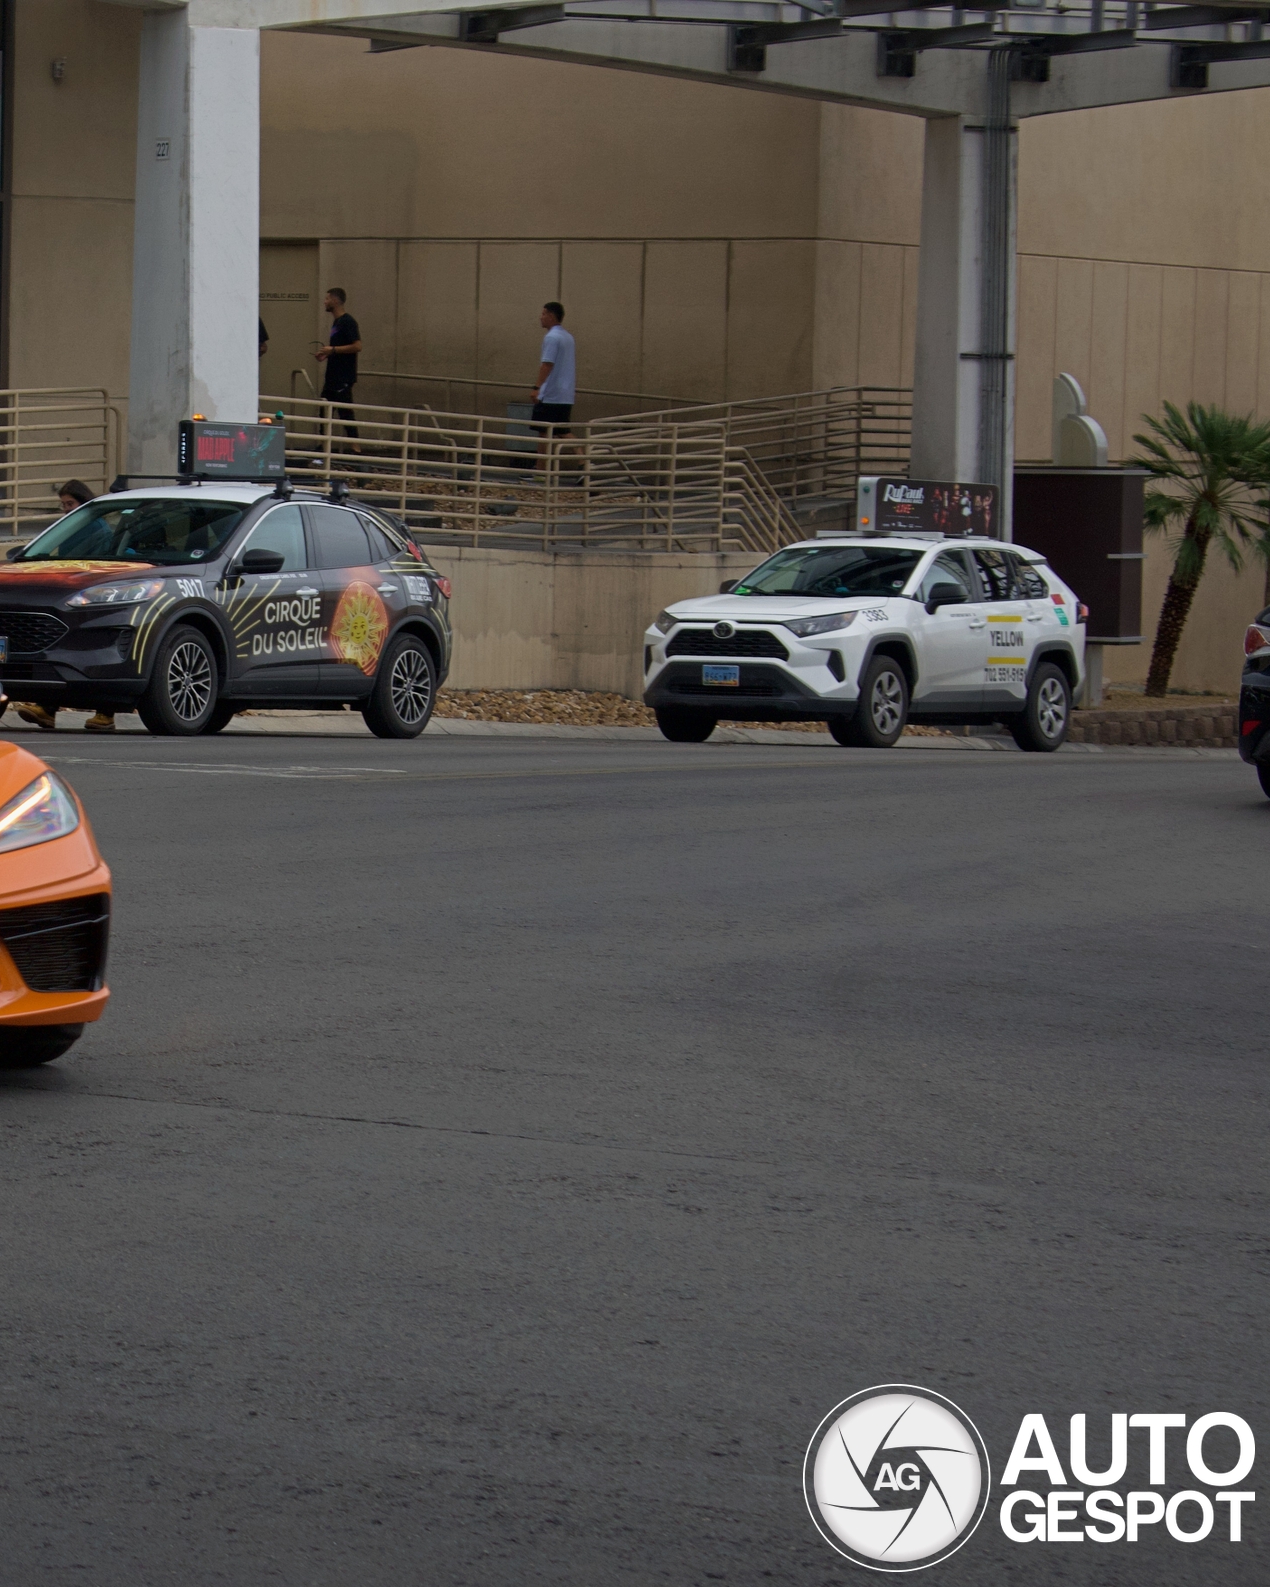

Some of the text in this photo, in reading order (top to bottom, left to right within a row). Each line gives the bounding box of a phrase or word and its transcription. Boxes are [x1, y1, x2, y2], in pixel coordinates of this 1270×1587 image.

[156, 142, 169, 157] 227
[176, 579, 205, 598] 5017
[264, 597, 321, 626] CIRQUE
[862, 609, 888, 622] 3383
[252, 627, 328, 655] DU SOLEIL
[990, 630, 1024, 646] YELLOW
[984, 667, 997, 681] 702
